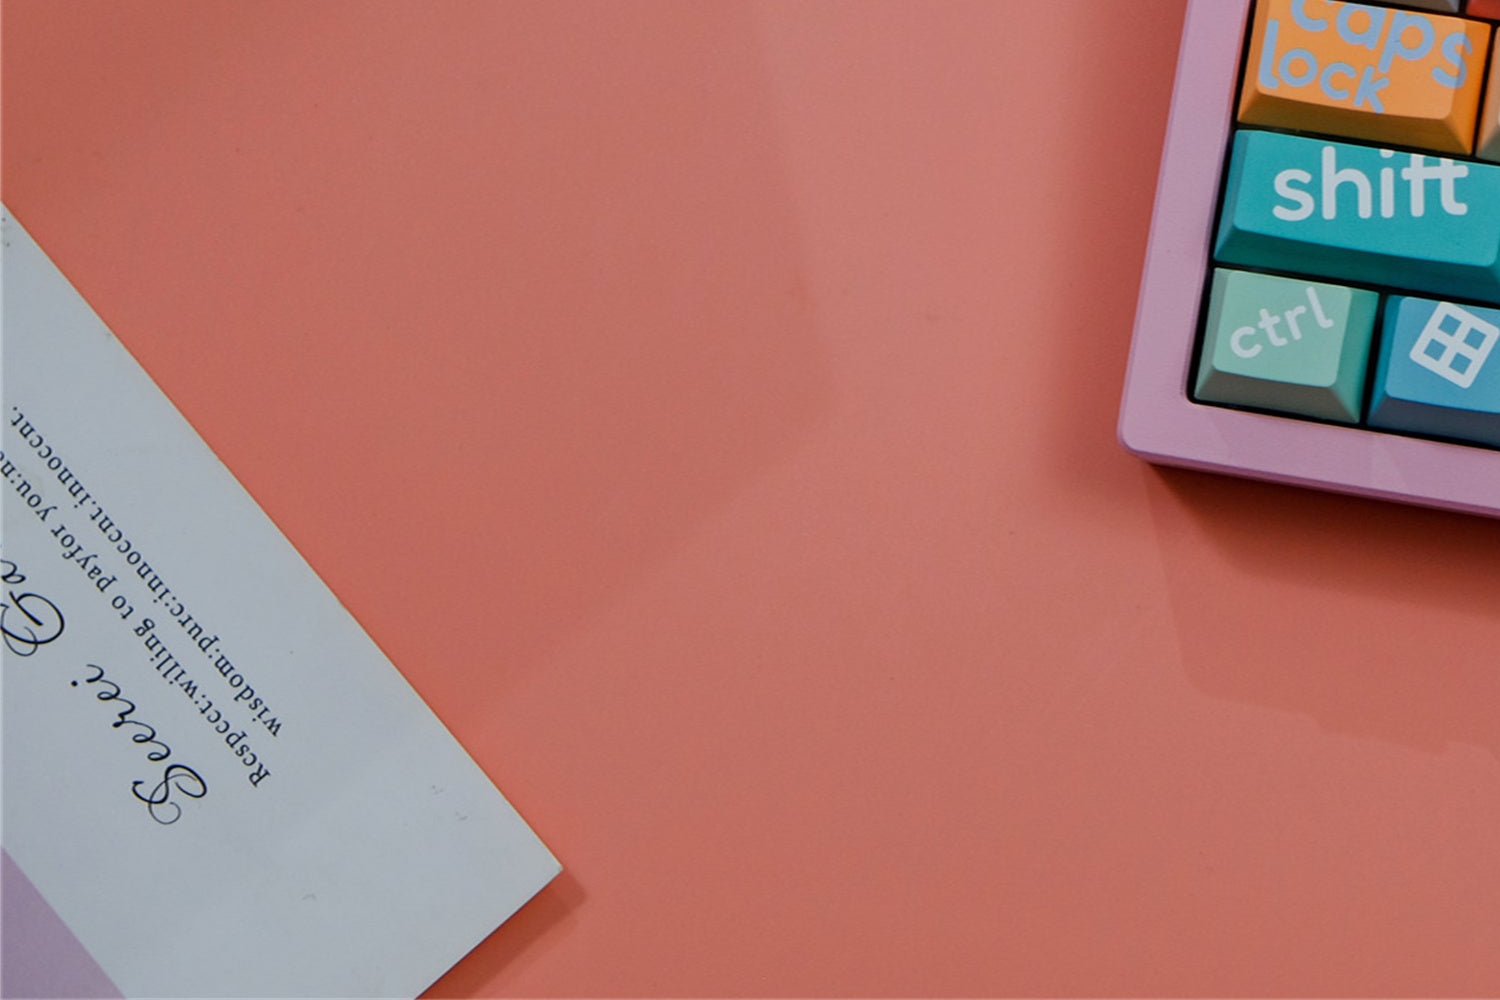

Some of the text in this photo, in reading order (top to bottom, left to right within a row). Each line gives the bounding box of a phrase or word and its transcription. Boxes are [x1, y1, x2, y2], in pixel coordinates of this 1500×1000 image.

[1258, 19, 1390, 113] lock
[1272, 146, 1469, 221] shift
[1230, 286, 1335, 359] ctrl
[111, 595, 136, 620] to
